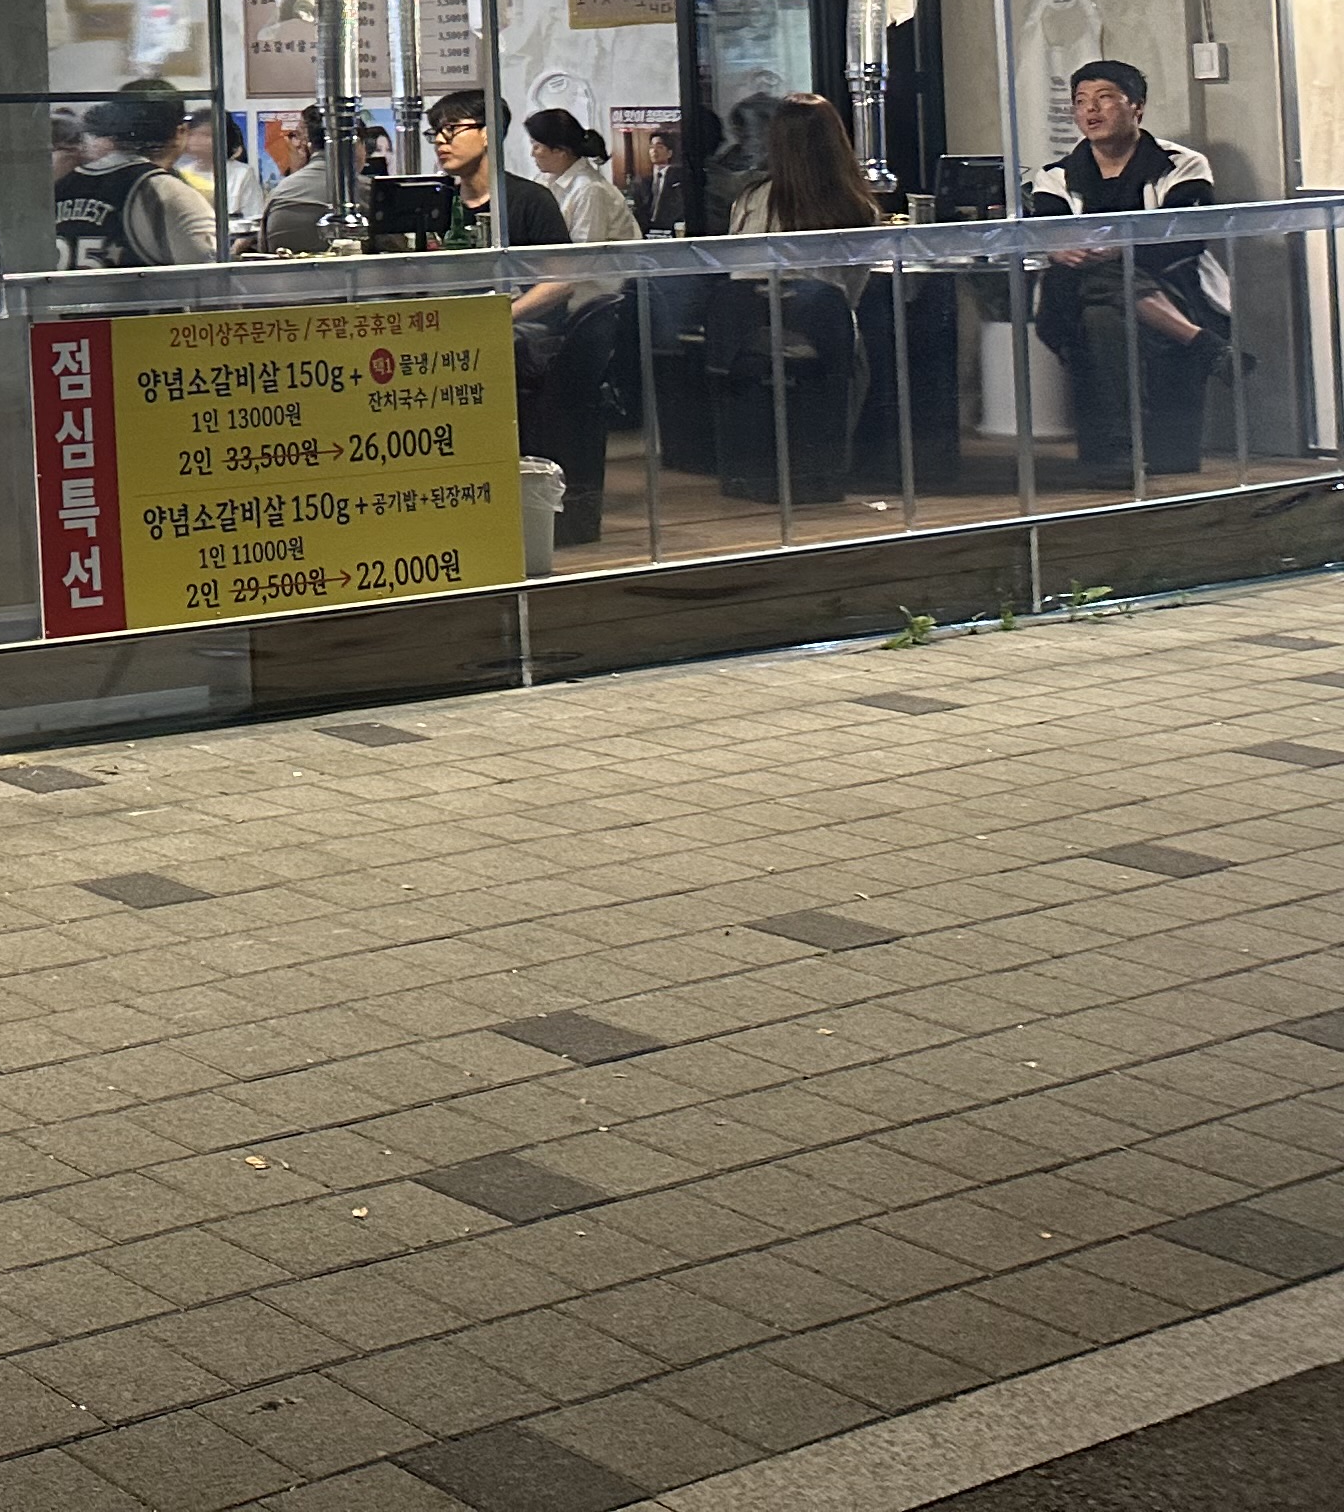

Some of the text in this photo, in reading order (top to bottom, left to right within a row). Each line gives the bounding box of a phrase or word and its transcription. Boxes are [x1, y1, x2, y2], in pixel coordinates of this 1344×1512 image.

[55, 198, 114, 226] IGHEST
[407, 310, 440, 332] 제외
[137, 360, 280, 403] 양념소갈비살
[287, 360, 344, 393] 150g
[192, 402, 302, 433] 1인 13000원
[179, 447, 213, 476] 2인
[349, 423, 455, 466] 26,000원
[51, 338, 105, 609] 점심특선
[143, 493, 287, 541] 양념소갈비살
[292, 492, 350, 525] 150g
[199, 536, 304, 569] 1인 11000원
[186, 579, 220, 609] 2인
[357, 549, 461, 593] 22,000원
